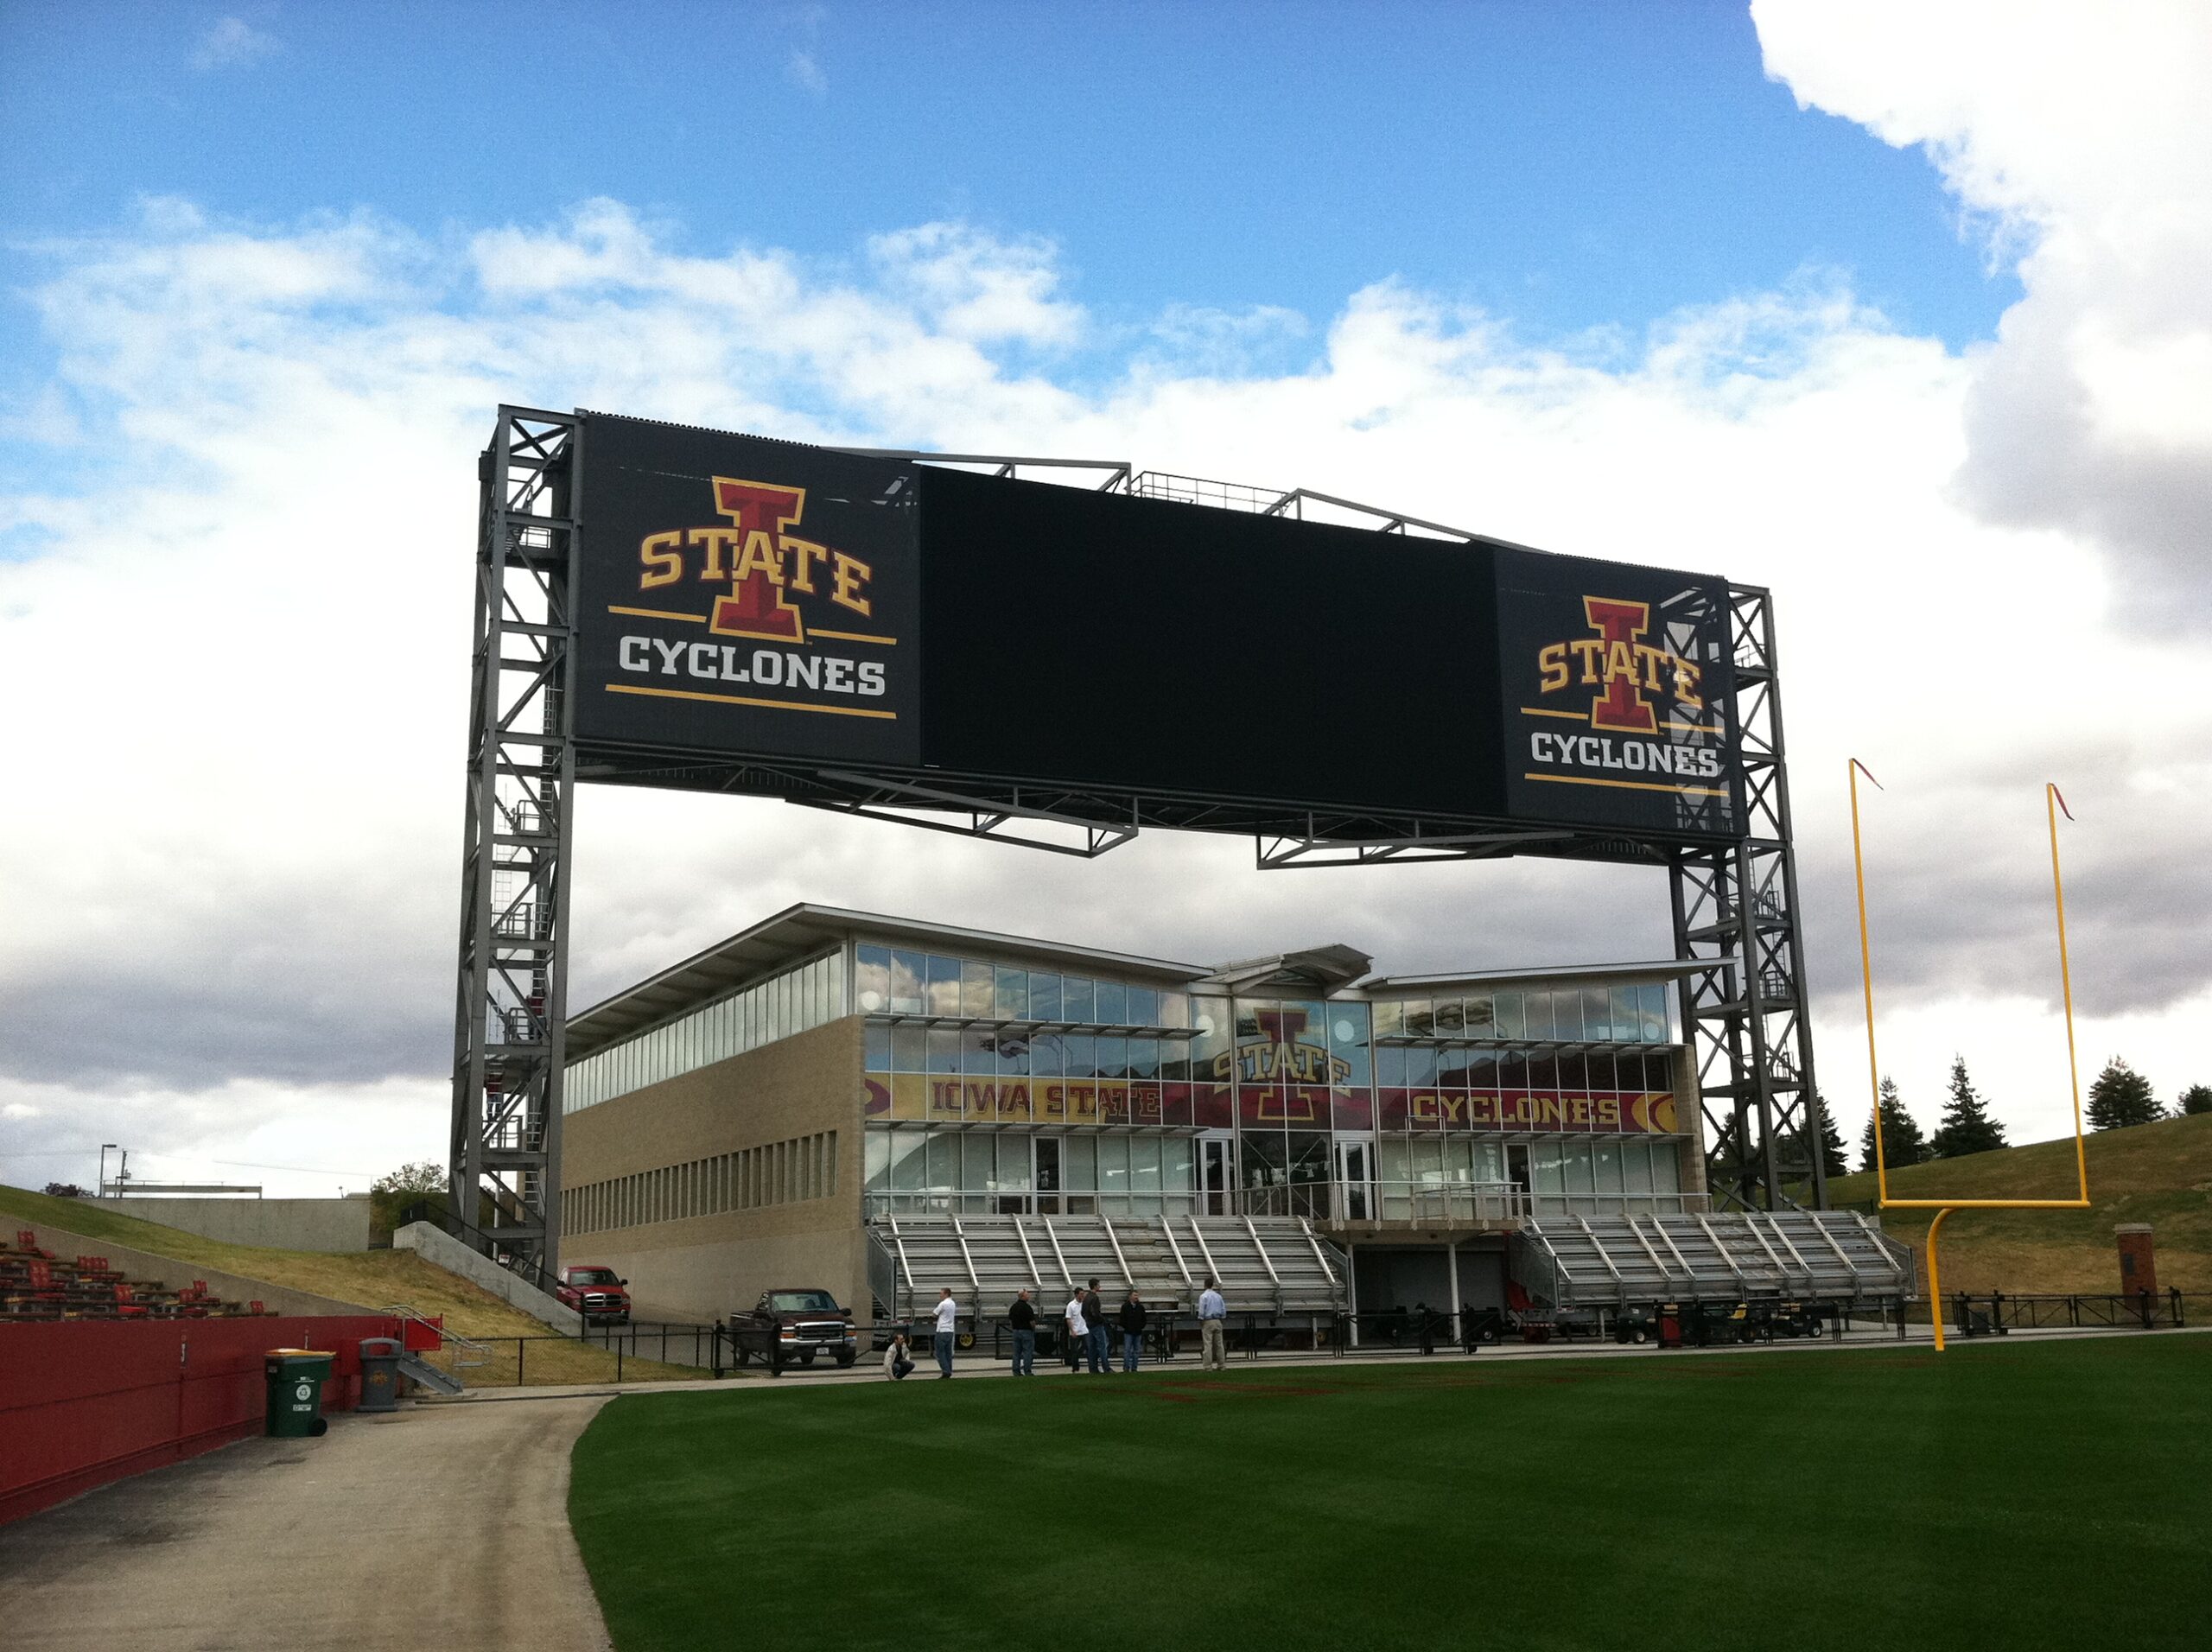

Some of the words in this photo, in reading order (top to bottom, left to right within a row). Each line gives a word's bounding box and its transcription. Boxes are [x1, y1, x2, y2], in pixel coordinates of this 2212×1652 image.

[639, 528, 872, 618] STATE
[620, 635, 885, 696] CYCLONES
[1539, 639, 1702, 709] STATE
[1531, 732, 1719, 778] CYCLONES
[1213, 1042, 1351, 1097] STATE
[932, 1082, 1031, 1114] IOWA
[1046, 1084, 1161, 1118] STATE
[1413, 1094, 1620, 1125] CYCLONES
